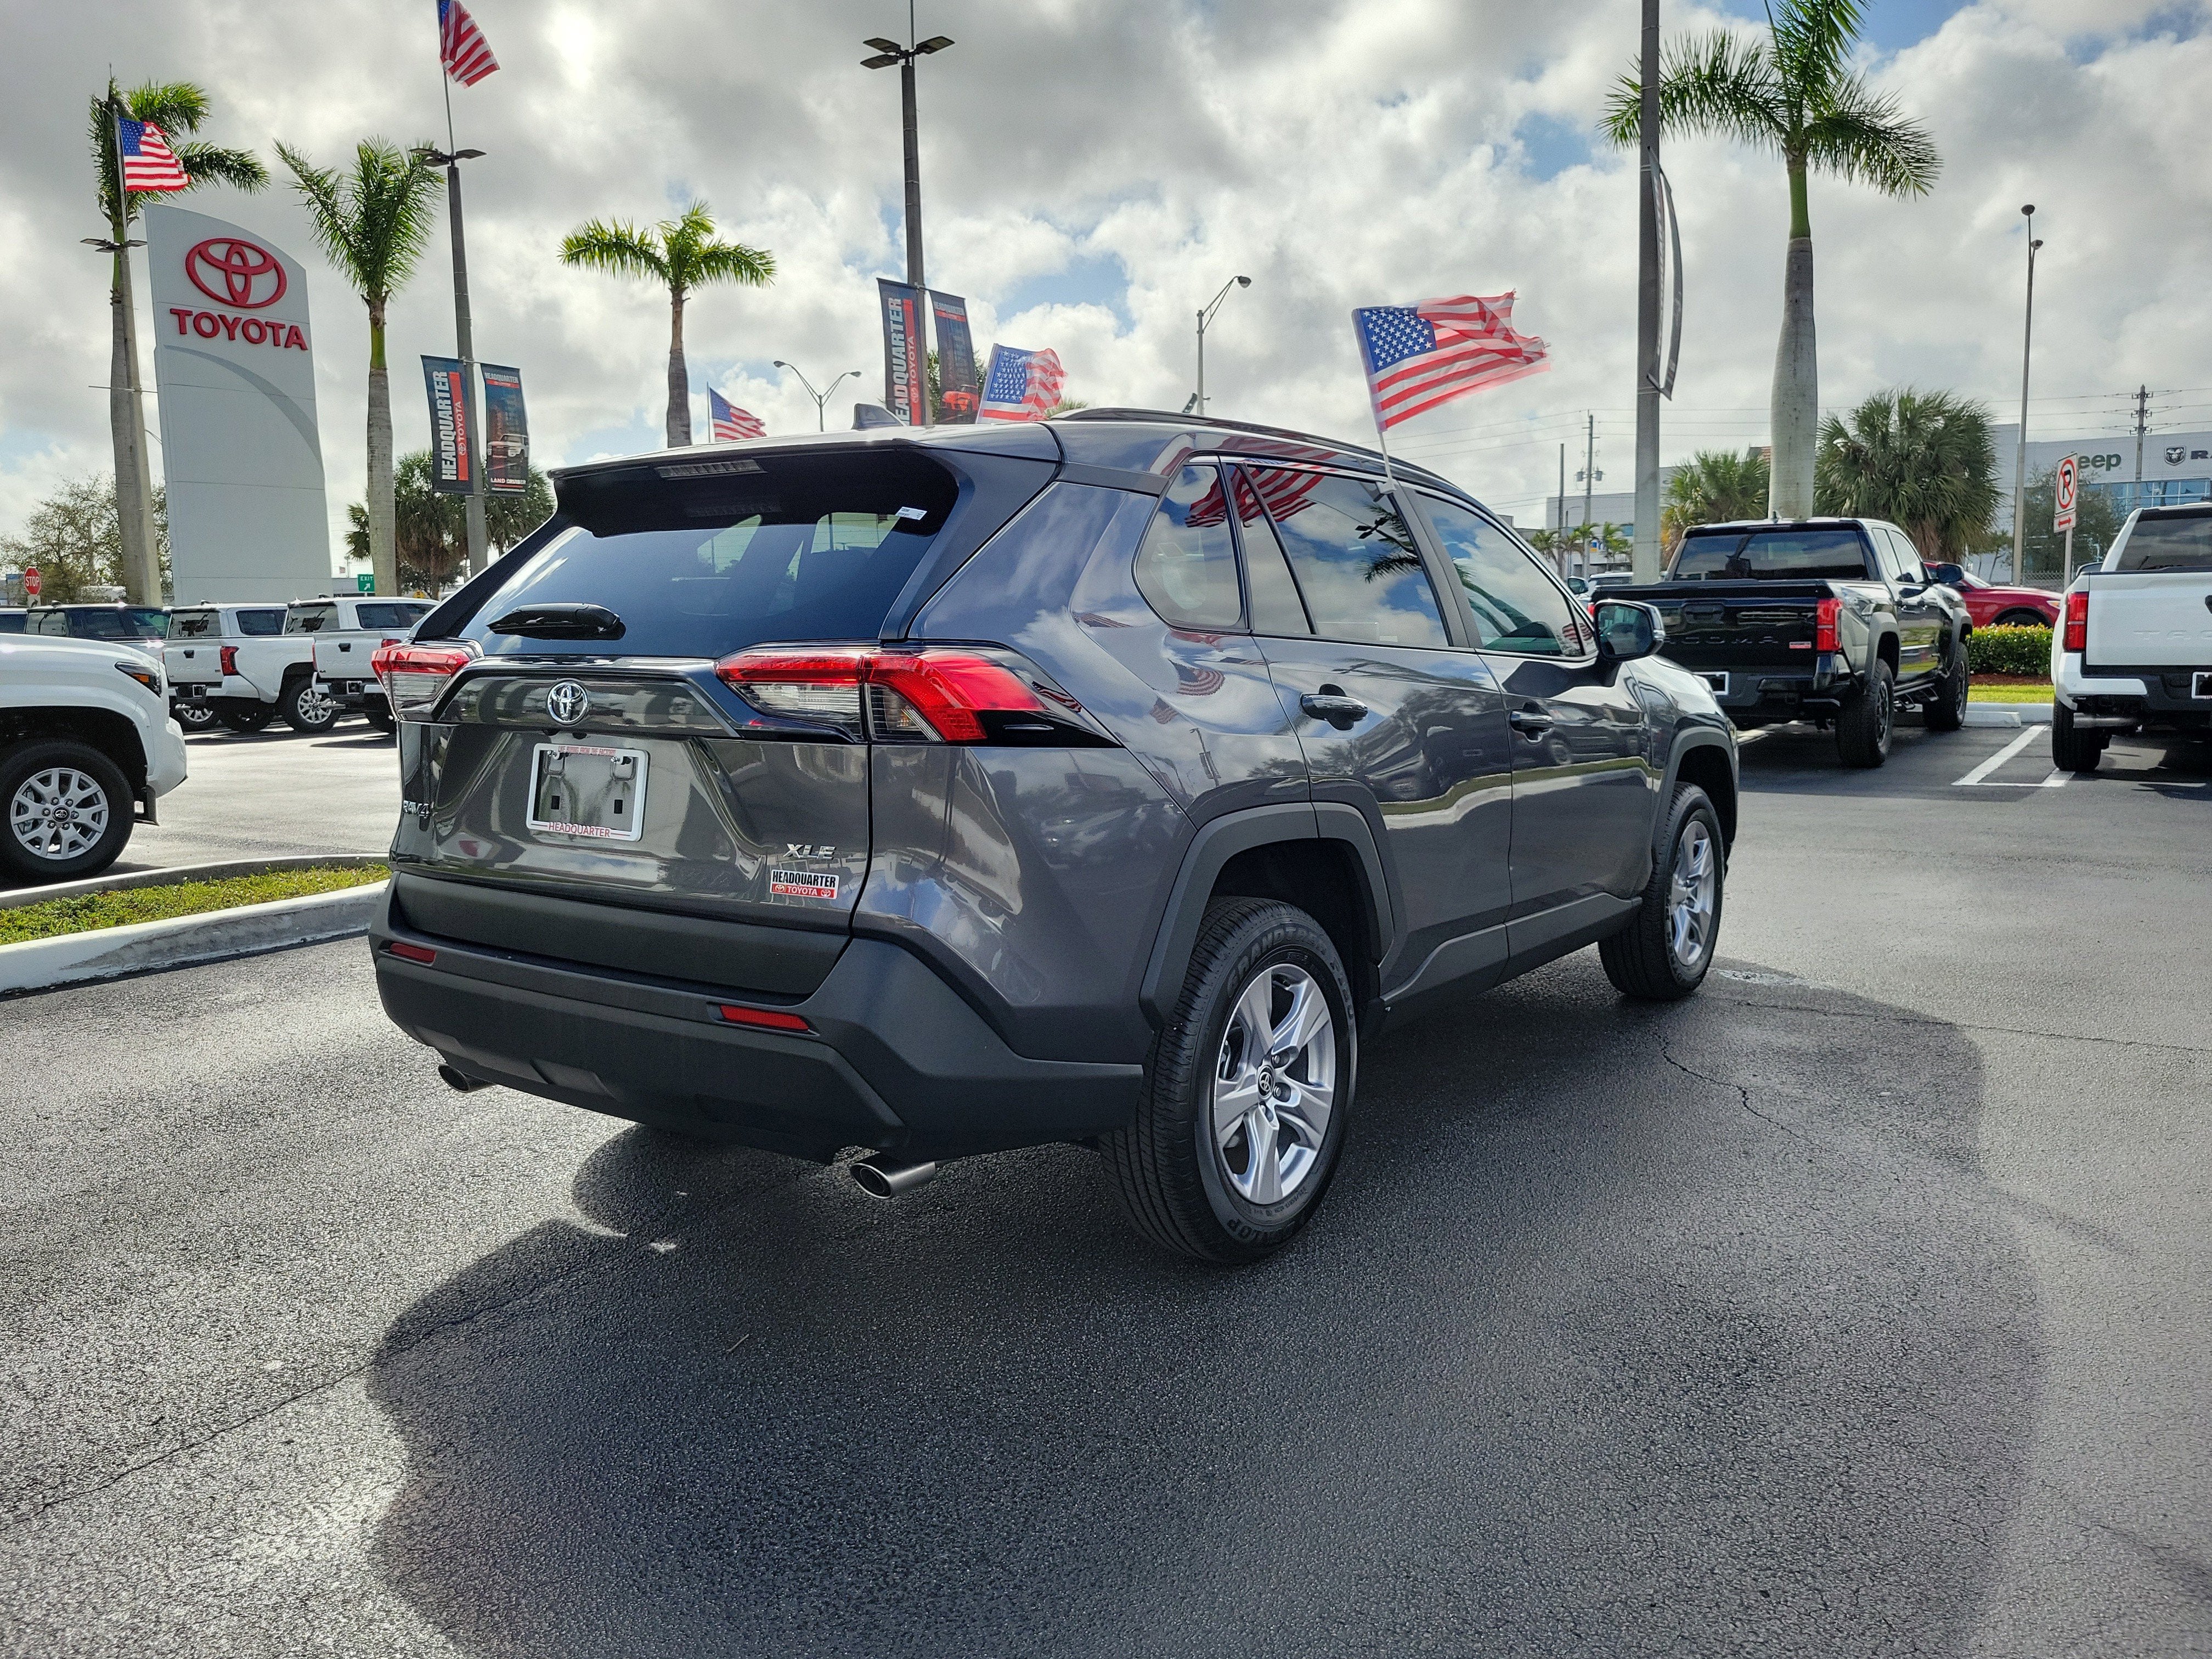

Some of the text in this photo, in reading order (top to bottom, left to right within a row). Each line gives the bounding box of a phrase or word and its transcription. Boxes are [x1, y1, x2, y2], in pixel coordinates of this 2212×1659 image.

[170, 308, 309, 351] TOYOTA
[907, 336, 919, 383] TOYOTA
[432, 371, 457, 481] HEADQUARTER
[455, 401, 467, 442] TOYOTA
[2078, 453, 2121, 471] eep
[2191, 450, 2212, 460] R
[25, 575, 40, 587] STOP
[1663, 636, 1779, 645] ACOMA
[403, 800, 430, 817] RAV4
[549, 822, 610, 837] HEADQUARTER
[783, 843, 837, 860] XLE
[772, 871, 836, 888] HEADQUARTER
[787, 885, 818, 896] TOYOTA
